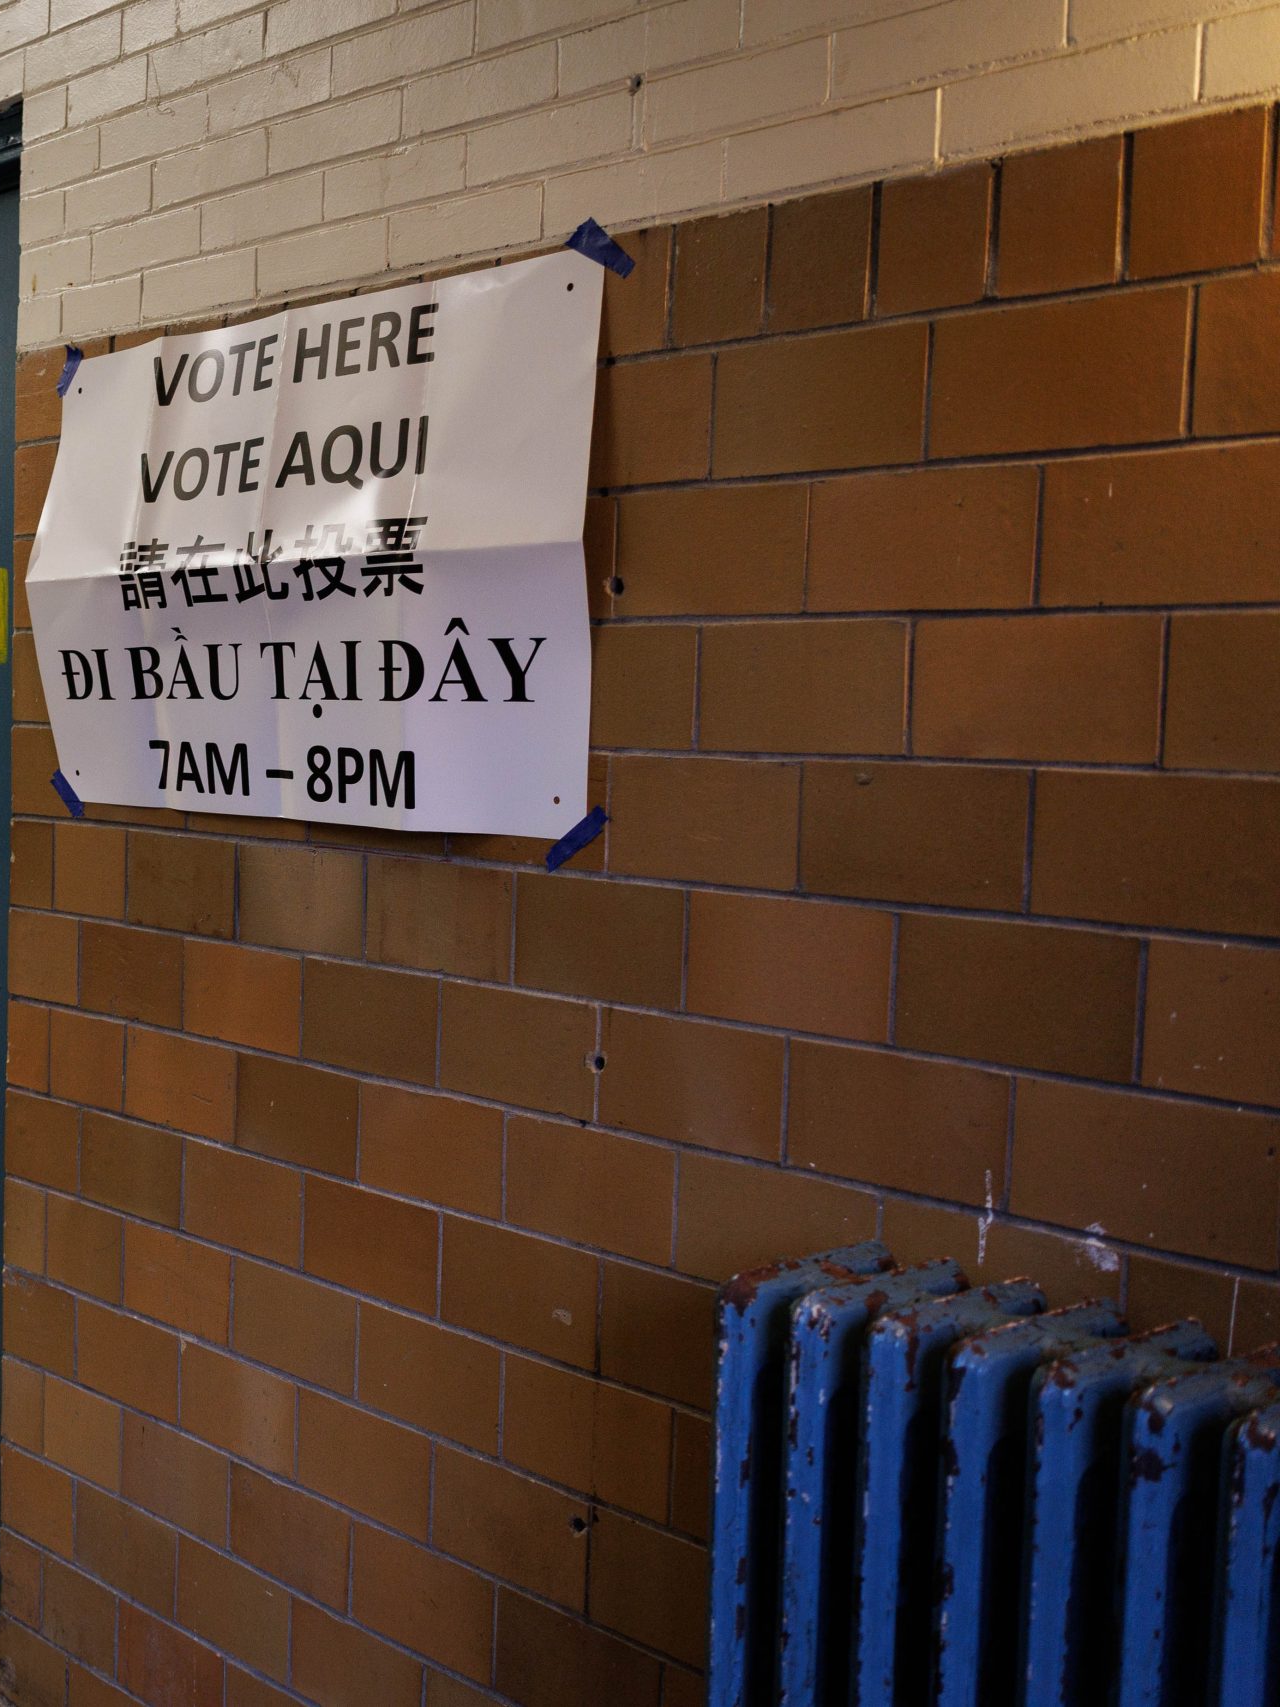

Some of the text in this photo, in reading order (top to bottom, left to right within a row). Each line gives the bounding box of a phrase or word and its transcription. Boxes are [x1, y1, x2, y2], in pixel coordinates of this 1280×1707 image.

[153, 302, 440, 407] VOTE HERE
[141, 415, 430, 504] VOTE AQUI
[119, 515, 429, 611] 請在此投票
[60, 617, 548, 719] ĐI BẦU TẠI ĐÂY
[148, 739, 252, 798] 7AM
[306, 744, 417, 810] 8PM
